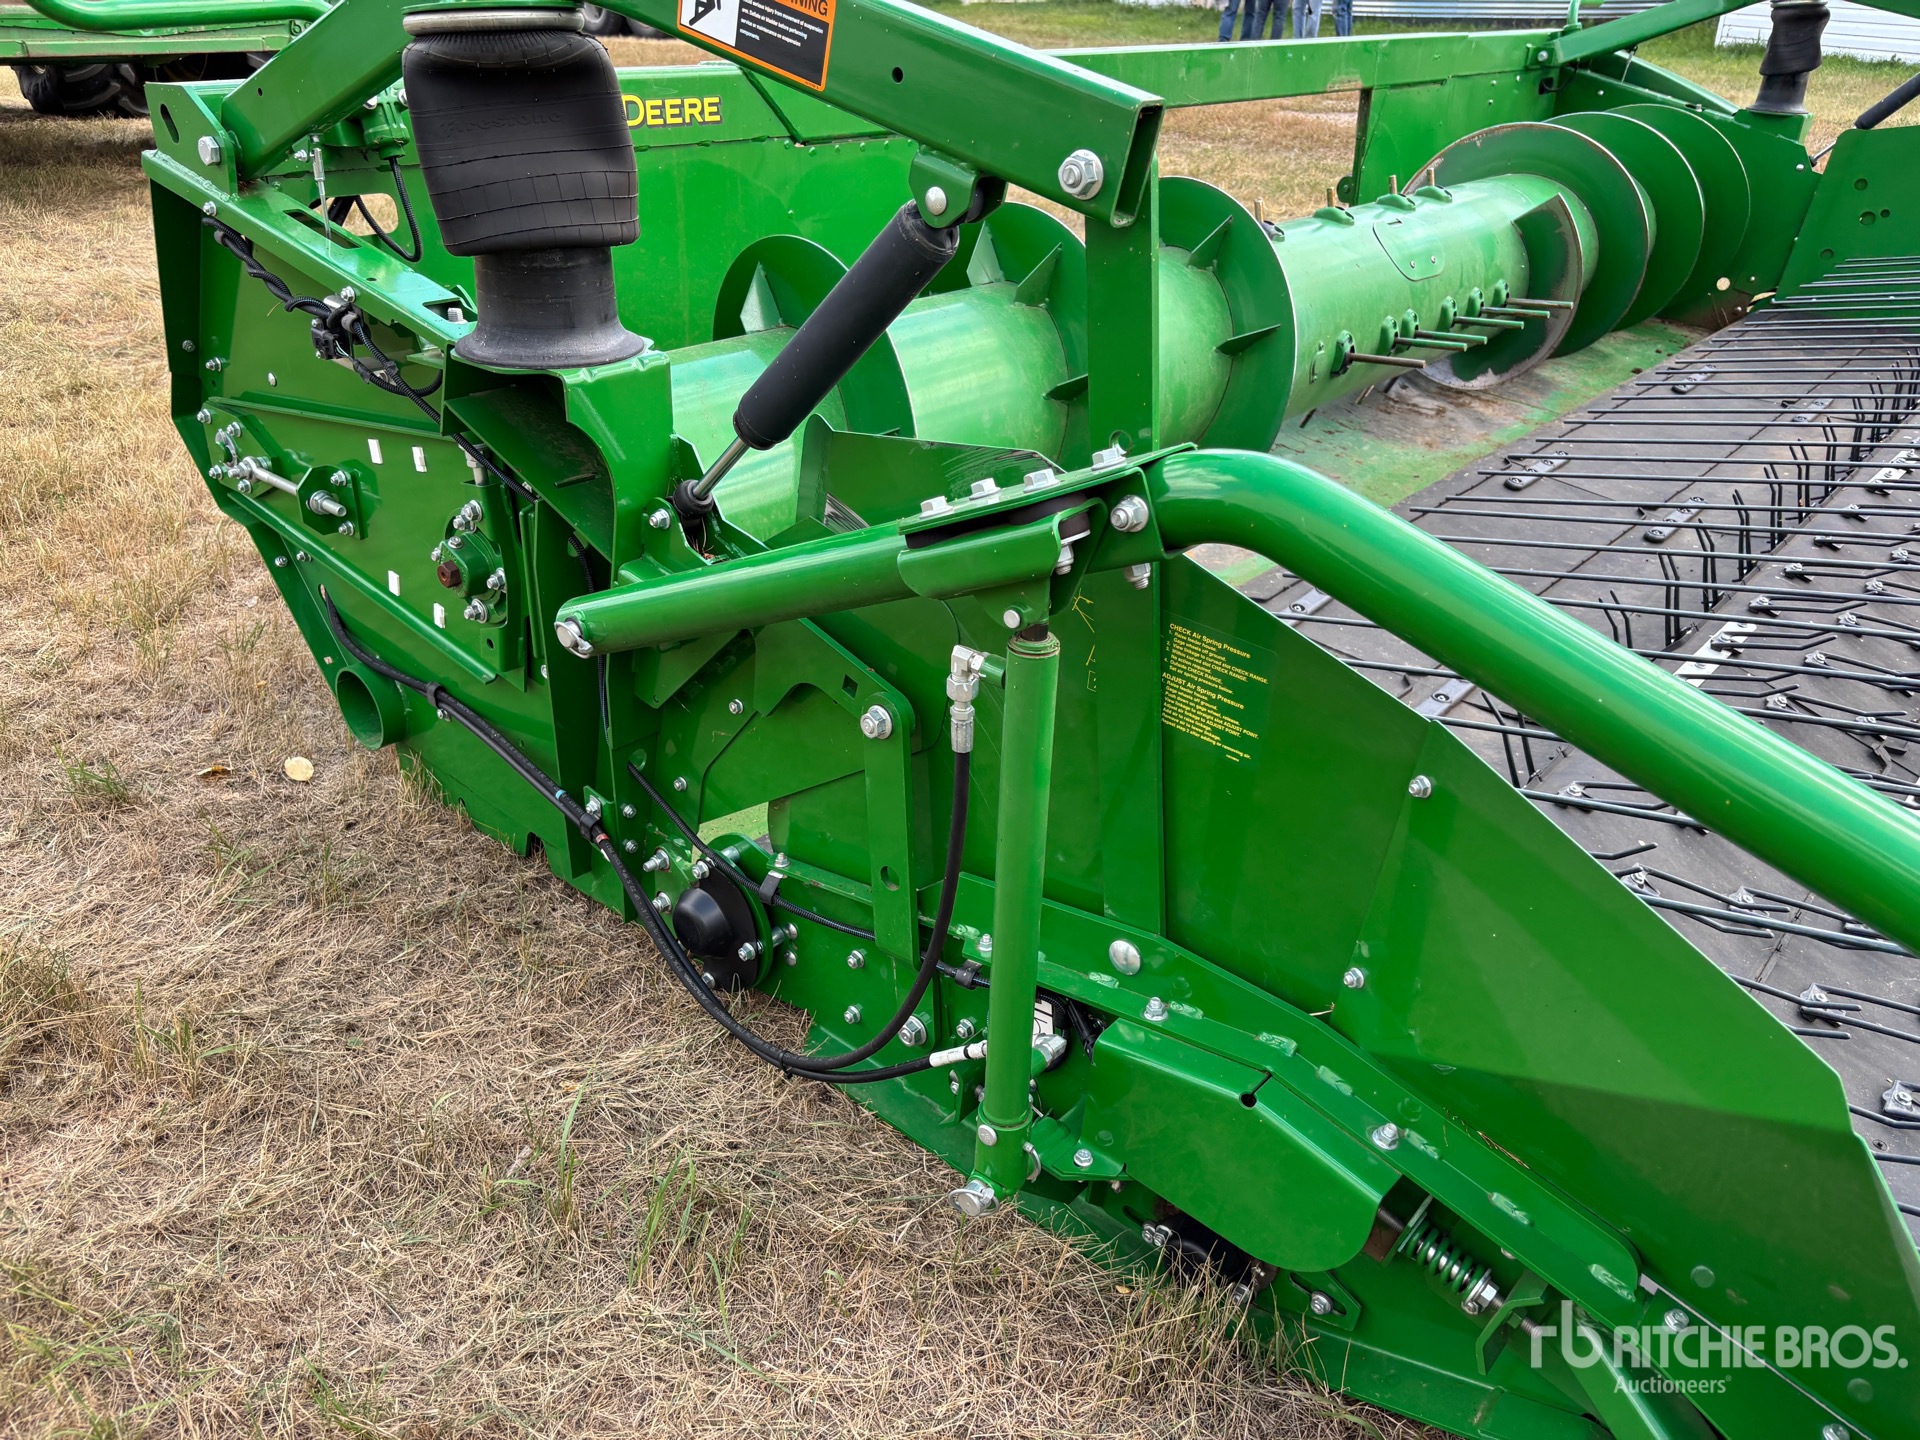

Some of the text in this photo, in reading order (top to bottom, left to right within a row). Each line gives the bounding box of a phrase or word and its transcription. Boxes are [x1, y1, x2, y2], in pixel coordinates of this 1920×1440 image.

[621, 95, 721, 127] DEERE
[1169, 623, 1191, 636] CHECK
[1203, 636, 1222, 649] Spring
[1224, 645, 1250, 659] Pressure
[1188, 667, 1204, 676] CHECK
[1212, 665, 1228, 674] CHECK
[1232, 667, 1248, 676] CHECK
[1162, 672, 1186, 686] ADJUST
[1197, 686, 1216, 699] Spring
[1218, 695, 1244, 710] Pressure
